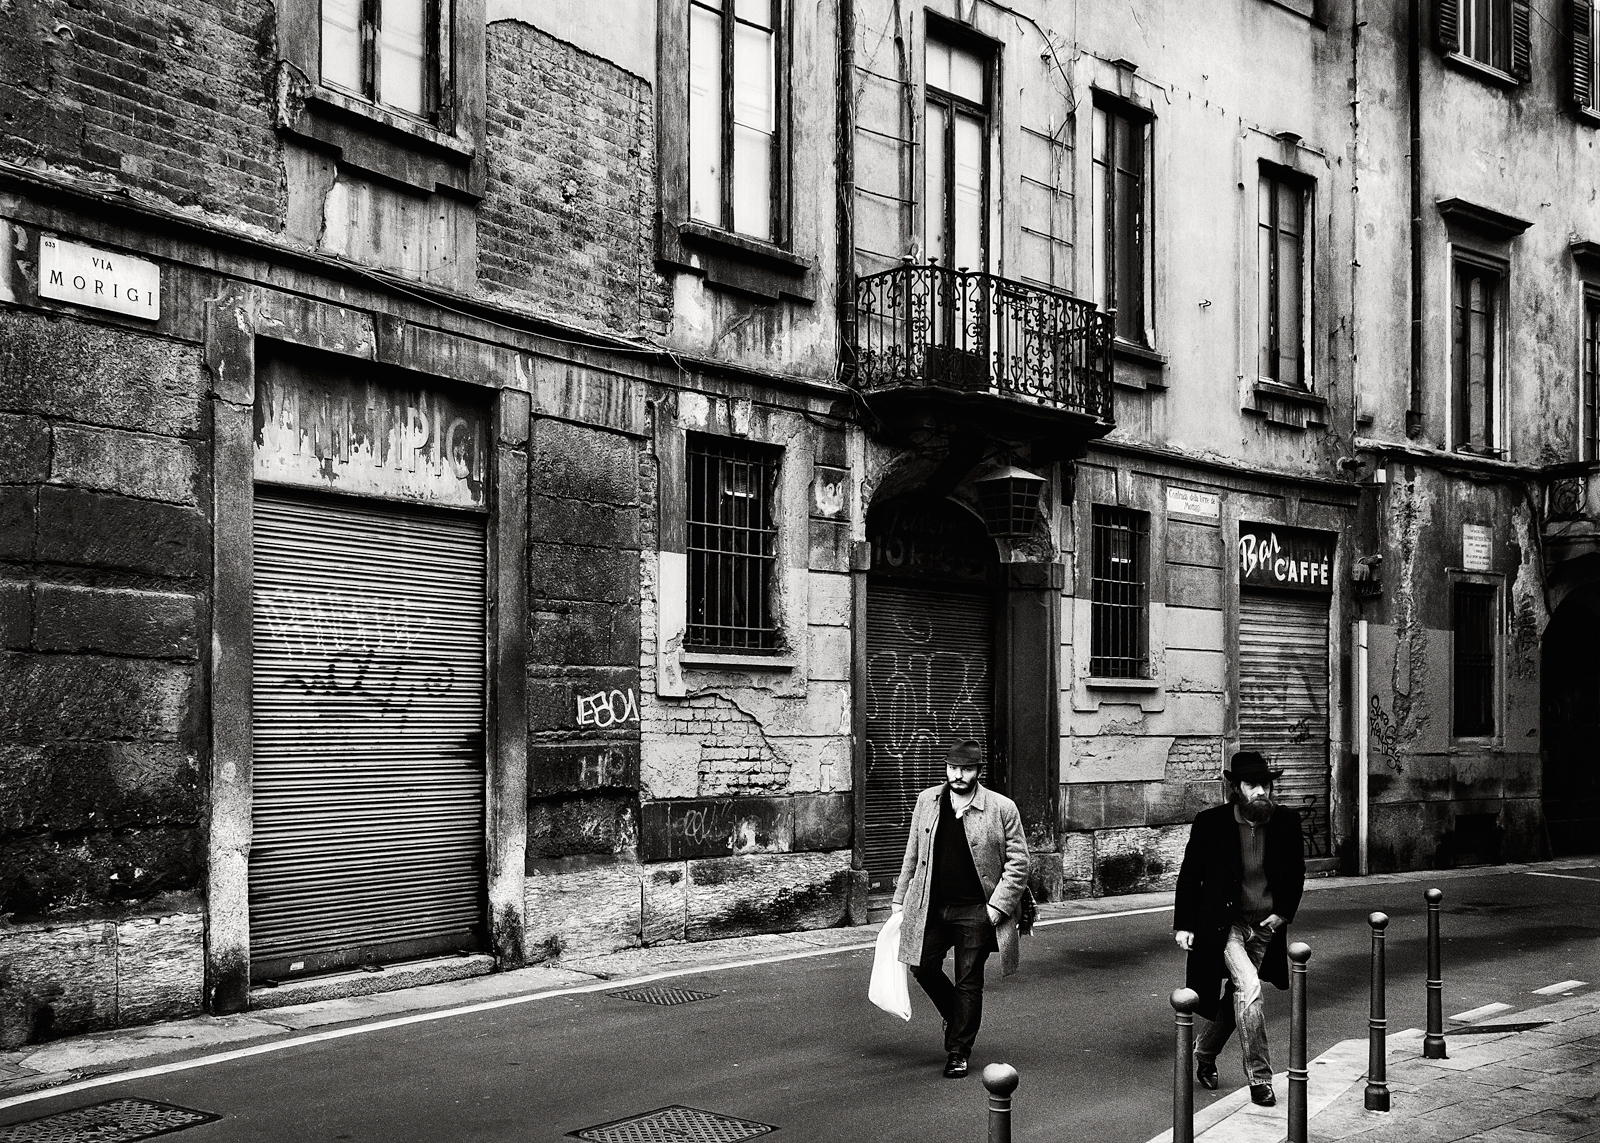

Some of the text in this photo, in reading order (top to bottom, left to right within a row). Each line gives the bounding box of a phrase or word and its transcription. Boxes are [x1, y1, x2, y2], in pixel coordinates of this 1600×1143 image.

[44, 240, 56, 249] 633
[91, 256, 113, 271] VIA
[49, 269, 153, 306] MORIGI
[1239, 531, 1281, 578] Bar
